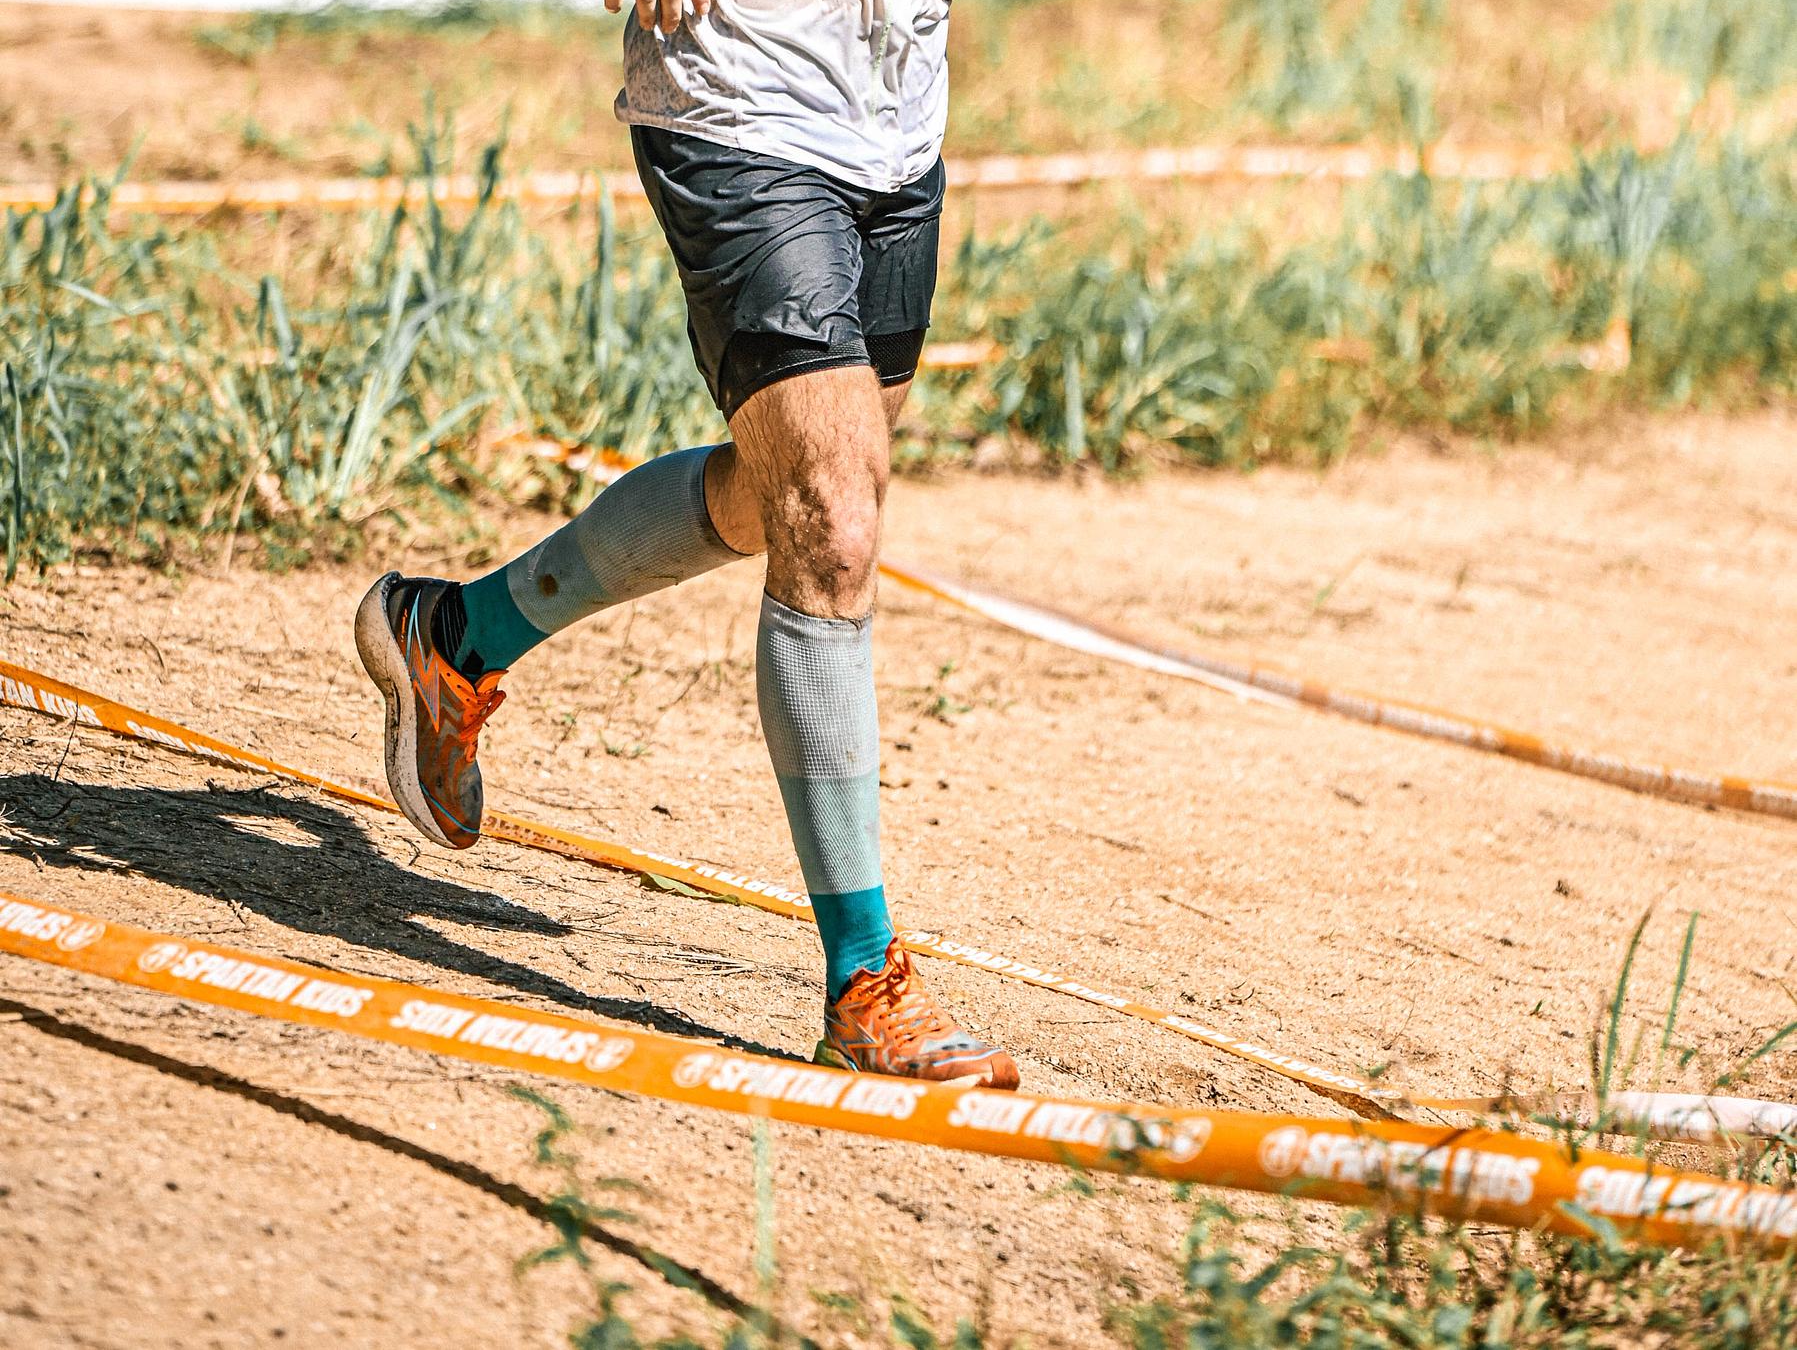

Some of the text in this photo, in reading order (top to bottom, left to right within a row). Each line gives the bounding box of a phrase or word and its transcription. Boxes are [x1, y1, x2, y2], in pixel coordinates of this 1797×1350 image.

[171, 950, 375, 1017] SPARTAN KIDS
[931, 940, 1065, 985] SPARTAN
[388, 999, 600, 1065] SPARTAN KIDS
[708, 1058, 927, 1121] SPARTAN KIDS
[946, 1091, 1037, 1135] KIDS
